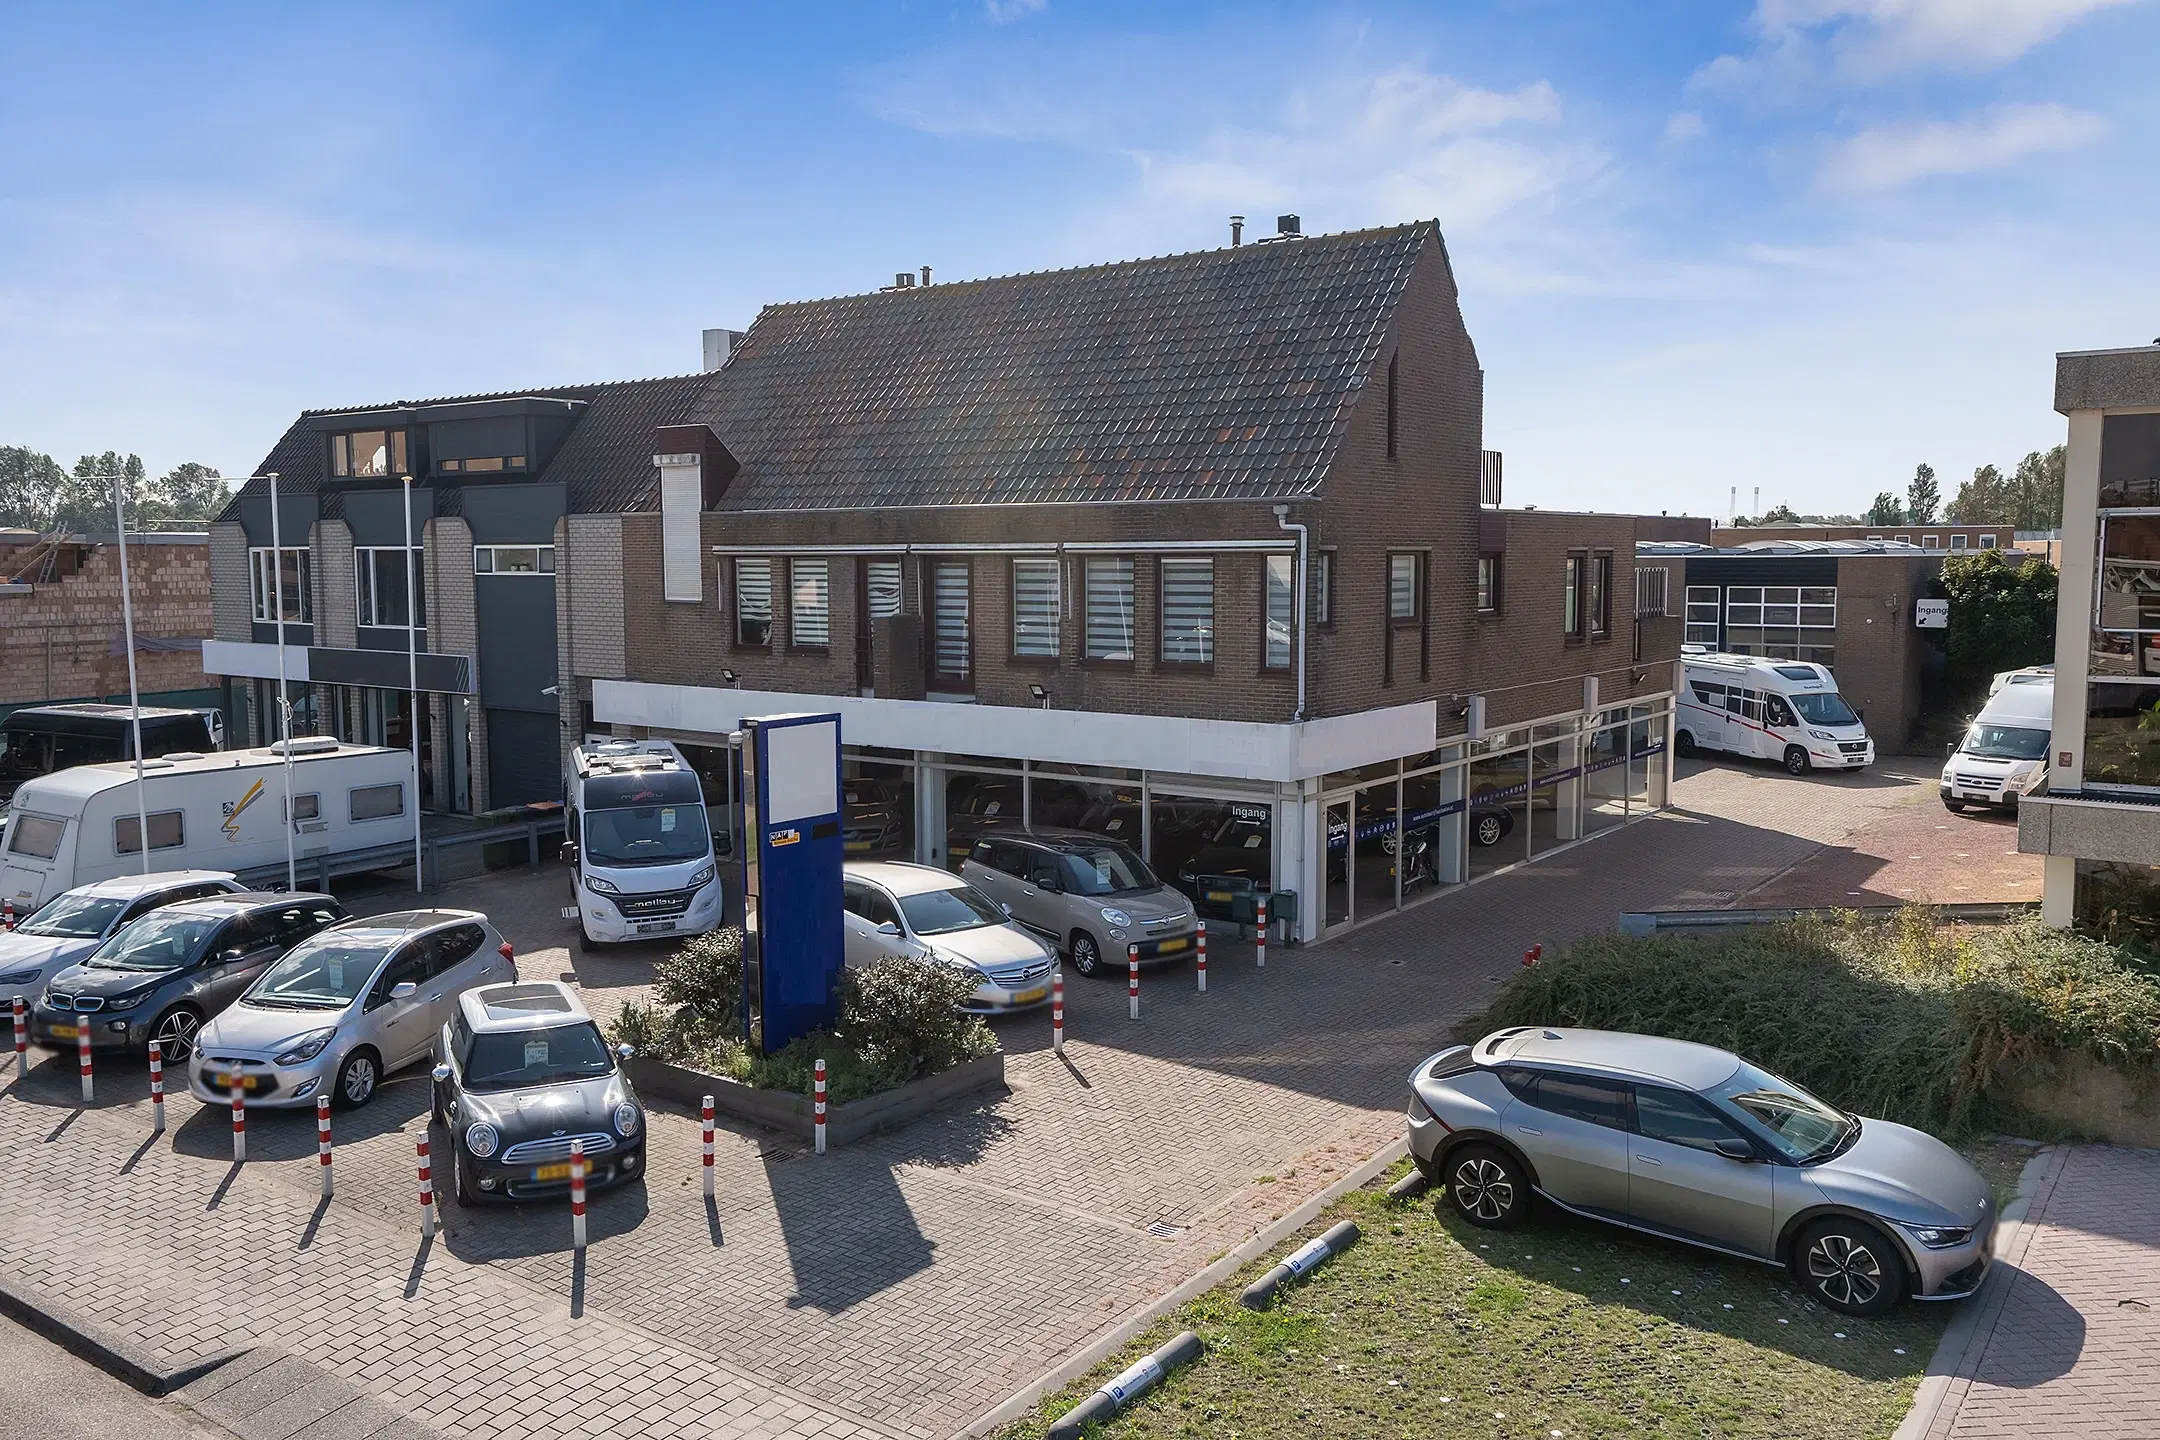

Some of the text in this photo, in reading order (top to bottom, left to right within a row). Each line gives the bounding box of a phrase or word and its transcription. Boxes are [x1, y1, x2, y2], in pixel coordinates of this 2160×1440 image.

[1918, 606, 1947, 615] Ingang
[1232, 805, 1266, 820] Ingang
[1328, 822, 1348, 835] Ingang
[634, 898, 676, 908] malibu
